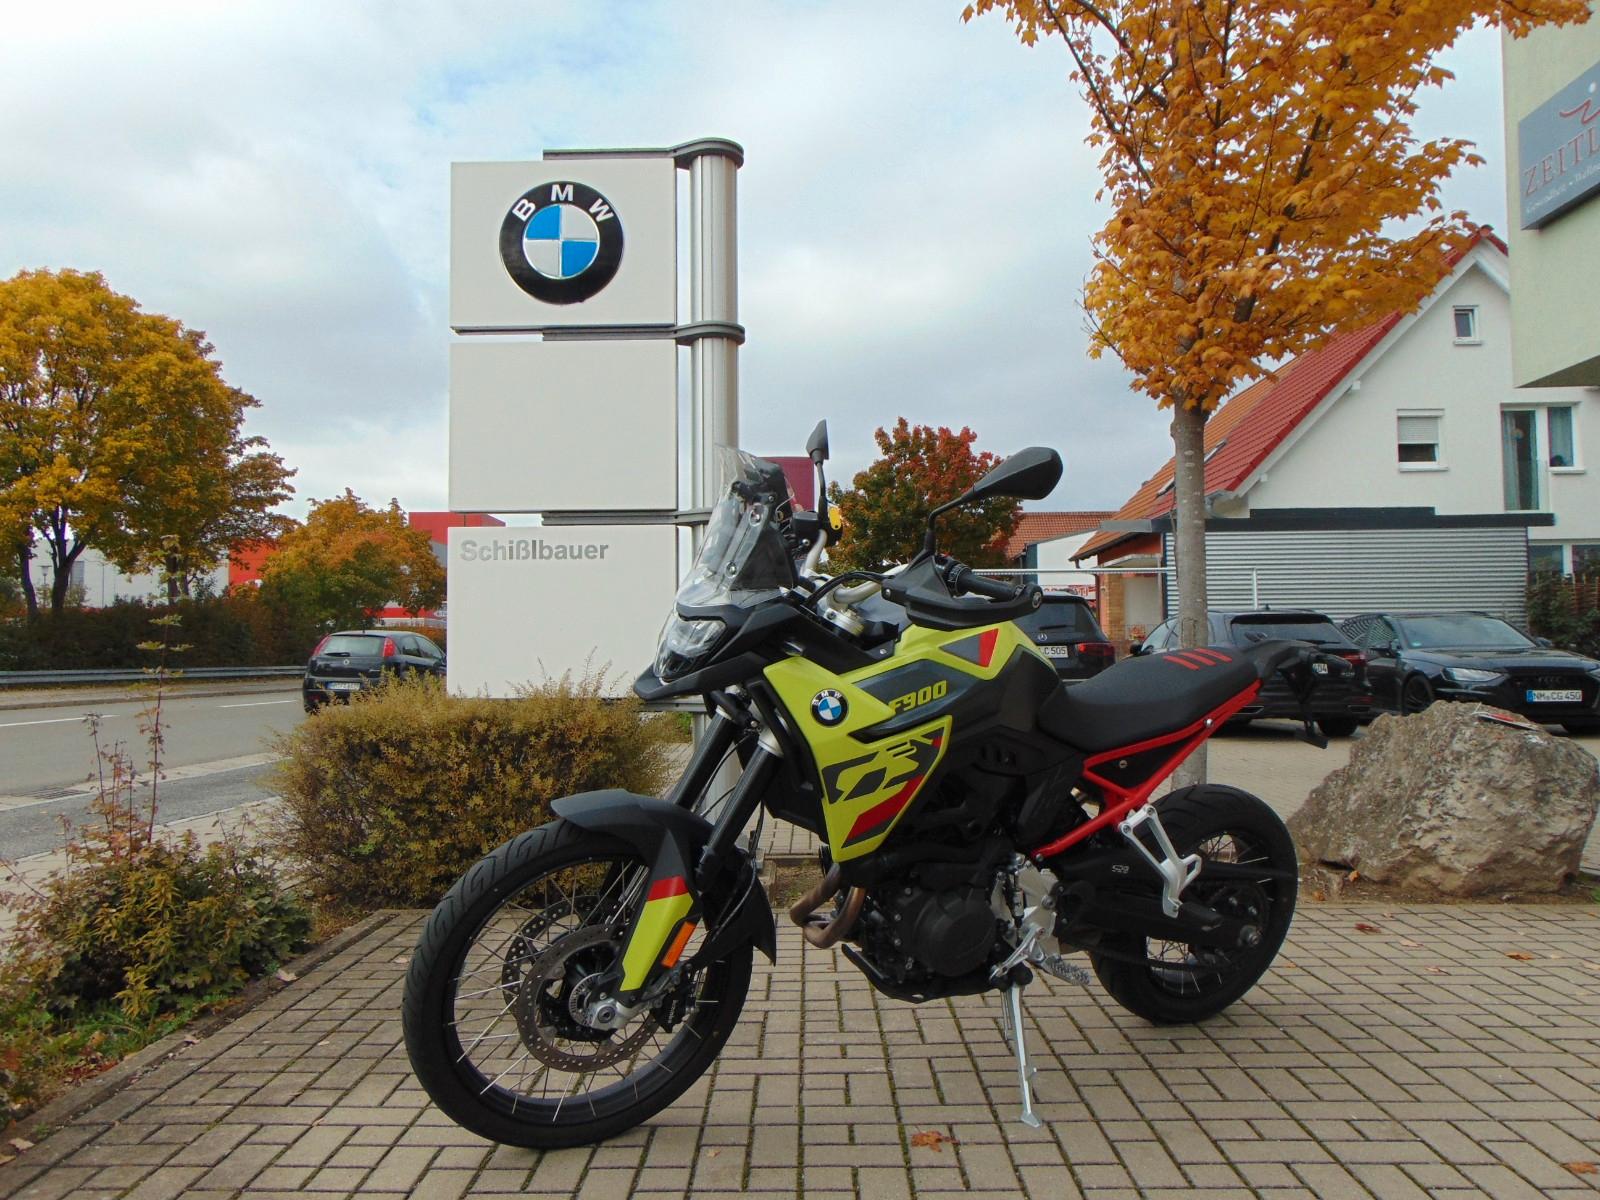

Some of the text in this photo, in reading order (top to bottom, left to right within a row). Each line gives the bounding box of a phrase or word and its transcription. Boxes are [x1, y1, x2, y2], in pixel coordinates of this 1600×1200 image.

[512, 184, 614, 222] BMW
[460, 539, 609, 561] Schißlbauer
[812, 690, 842, 706] BMW
[887, 680, 947, 713] F900
